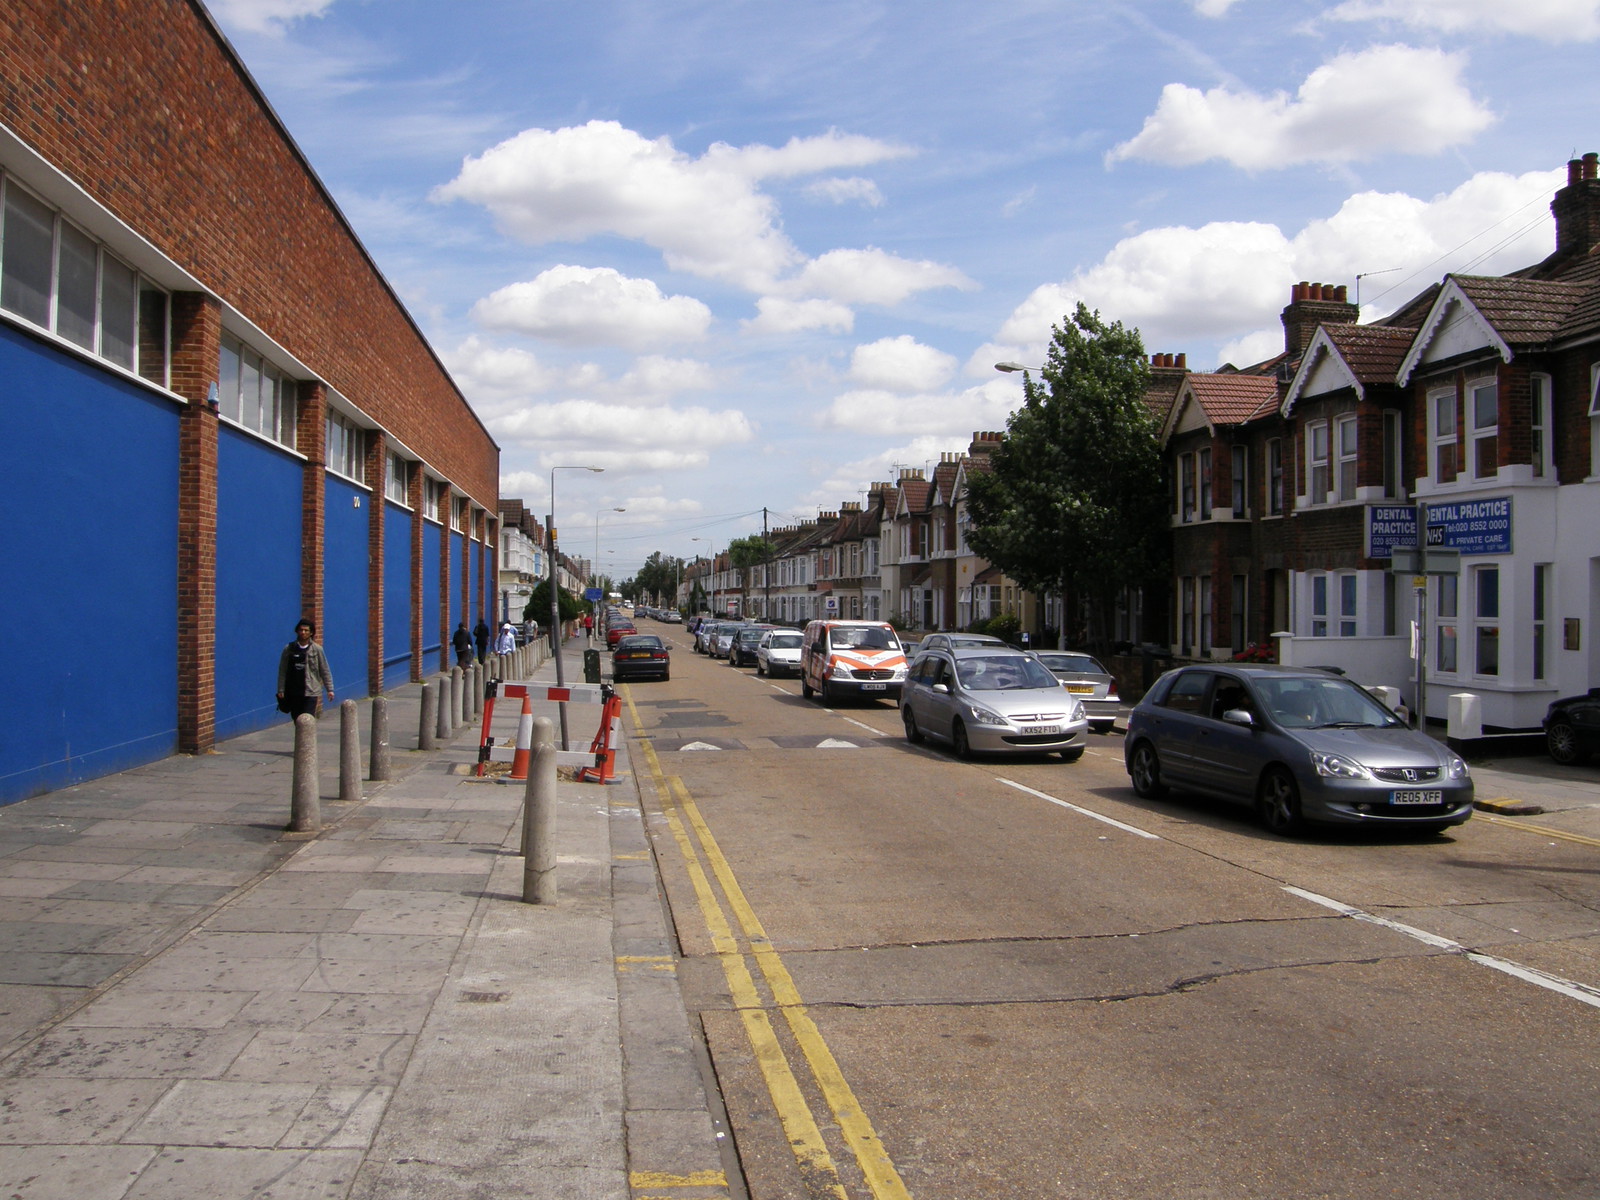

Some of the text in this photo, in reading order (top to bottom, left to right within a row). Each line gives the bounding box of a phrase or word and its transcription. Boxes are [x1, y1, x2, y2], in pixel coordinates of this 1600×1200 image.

[1376, 509, 1411, 520] DENTAL
[1460, 500, 1508, 519] PRACTICE
[1372, 522, 1416, 534] PRACTICE
[1470, 521, 1487, 531] 8552
[1488, 519, 1508, 530] 0000
[1426, 527, 1443, 543] NHS
[1456, 535, 1483, 545] PRIVATE
[1484, 534, 1503, 543] CARE
[1373, 537, 1384, 545] 020
[1400, 537, 1416, 545] 0000
[1395, 791, 1440, 802] RE05 XFF
